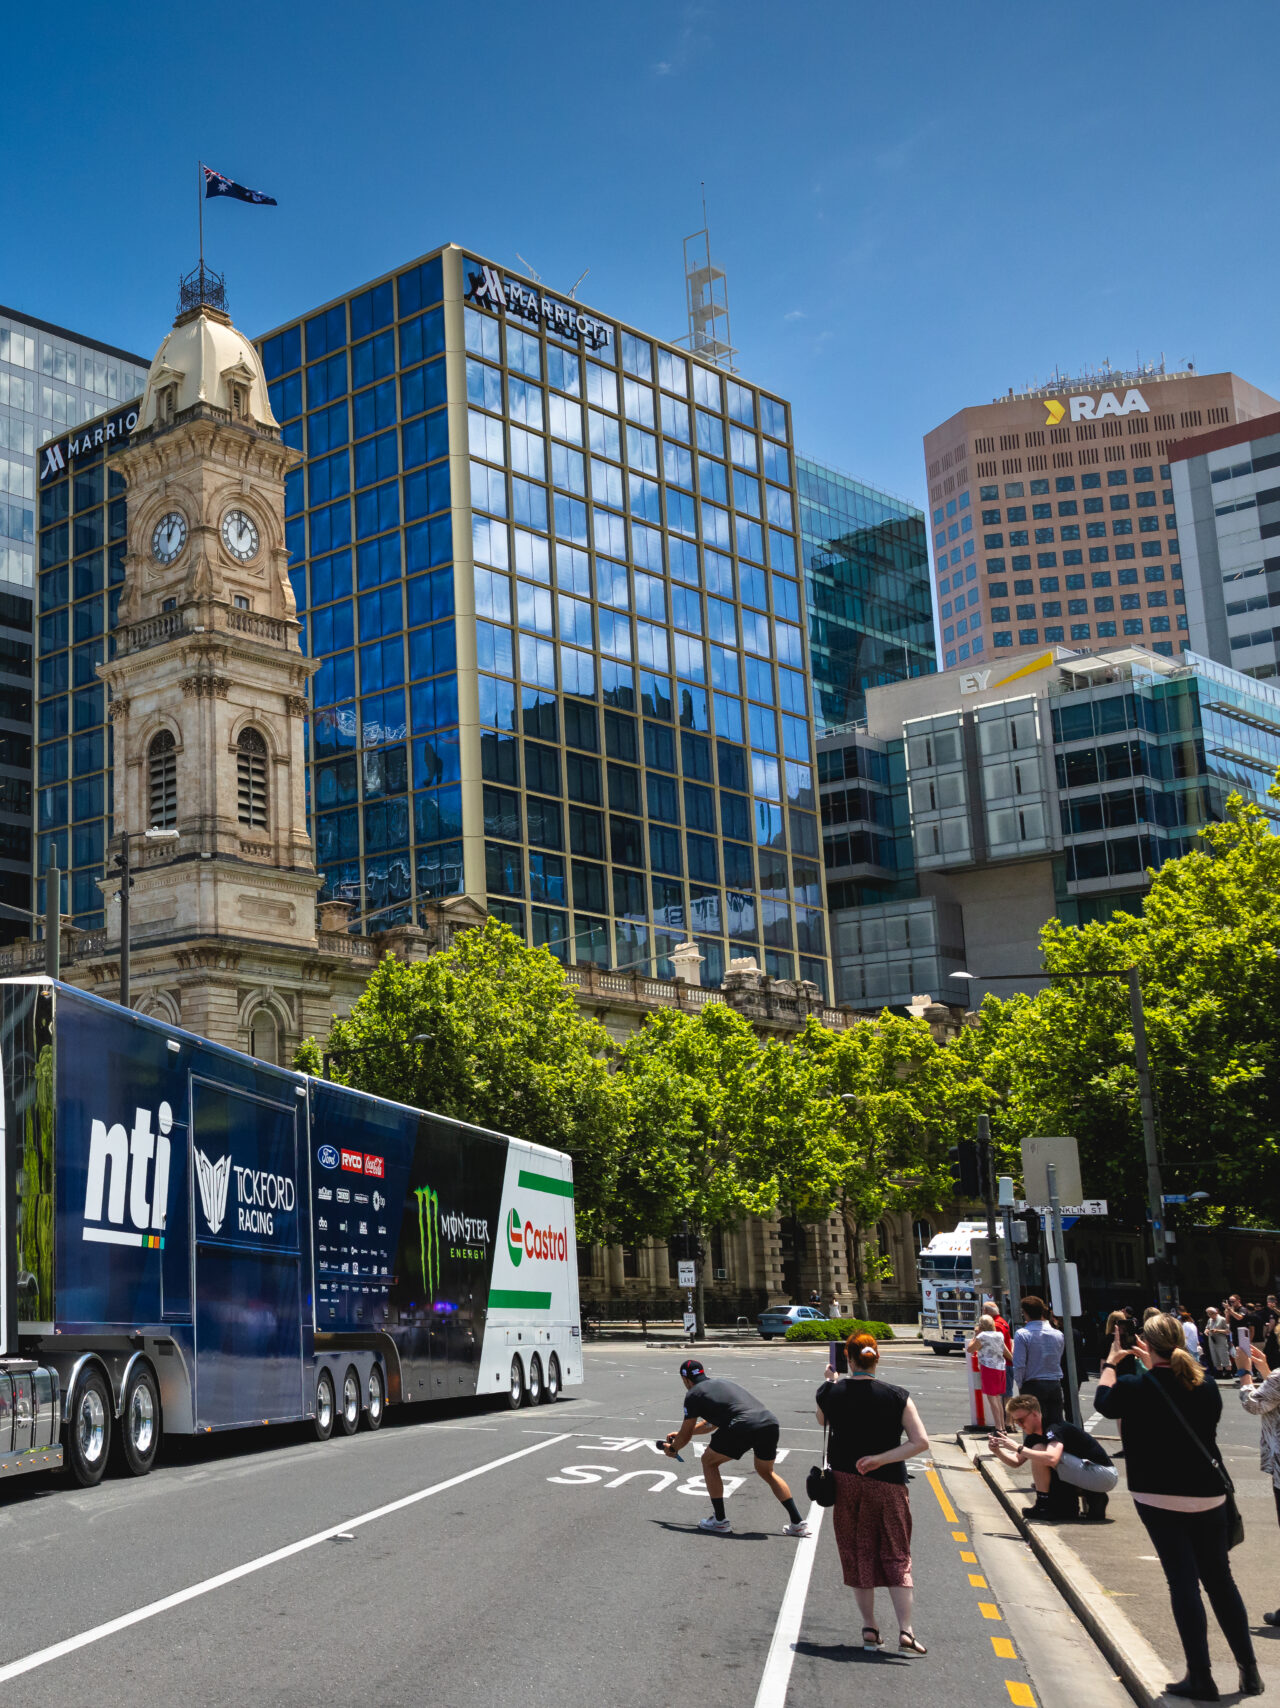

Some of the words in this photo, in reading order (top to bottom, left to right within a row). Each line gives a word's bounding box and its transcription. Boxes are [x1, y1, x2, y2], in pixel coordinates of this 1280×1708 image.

[509, 284, 614, 346] MARRIOTT
[1069, 388, 1151, 422] RAA
[67, 411, 139, 459] MARRIO
[959, 669, 992, 695] EY
[84, 1101, 173, 1232] nti
[321, 1147, 336, 1165] Ford
[341, 1153, 362, 1169] RYCO
[233, 1165, 296, 1212] TICKFORD
[238, 1208, 274, 1236] RACING
[440, 1210, 491, 1244] MONSTER
[450, 1247, 485, 1260] ENERGY
[524, 1220, 568, 1262] Castrol
[546, 1465, 748, 1499] BUS
